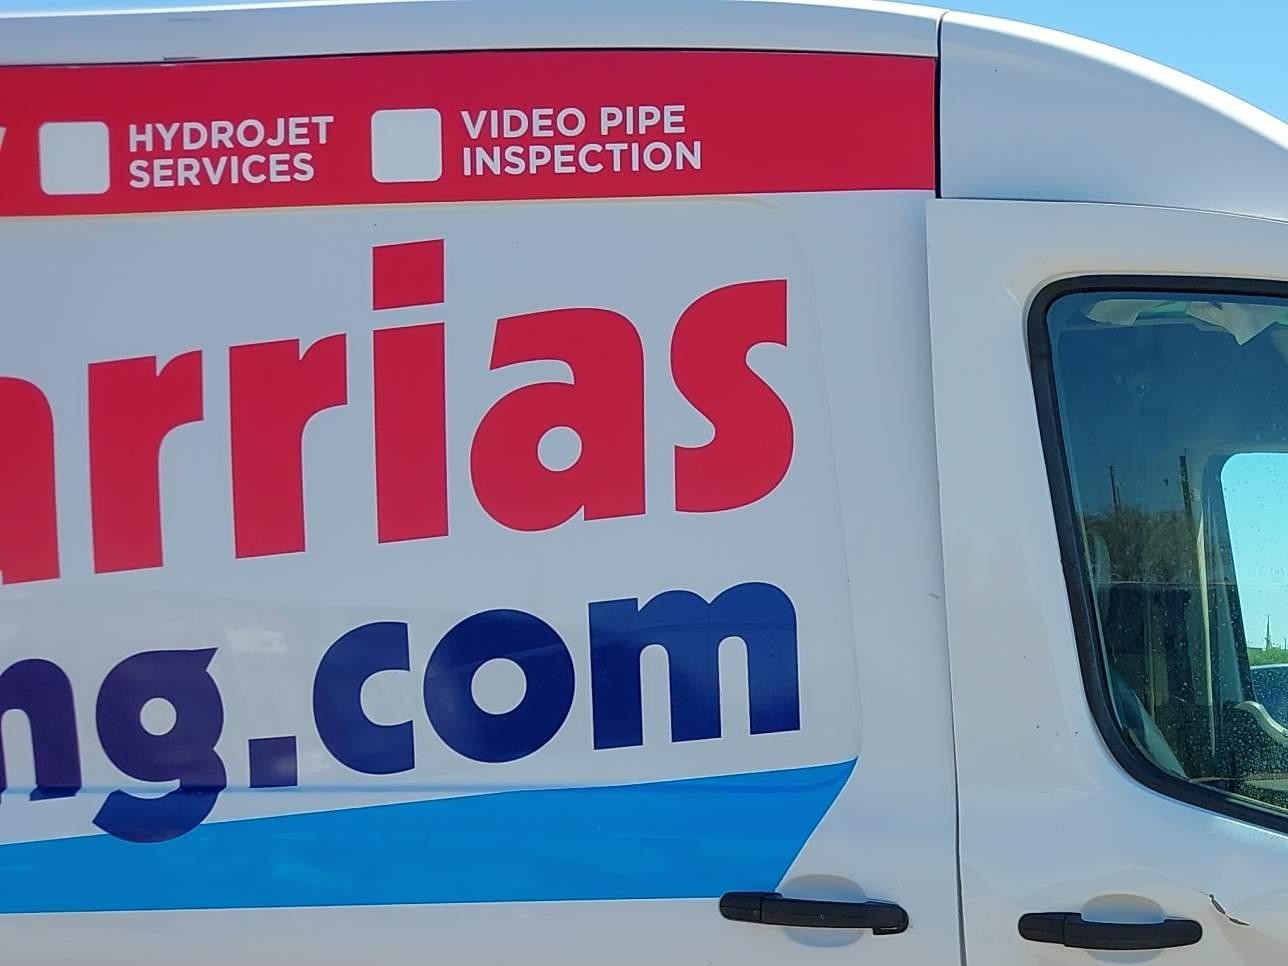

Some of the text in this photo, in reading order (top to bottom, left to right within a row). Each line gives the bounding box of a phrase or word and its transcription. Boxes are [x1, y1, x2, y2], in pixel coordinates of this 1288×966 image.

[129, 115, 334, 152] HYDROJET
[460, 104, 686, 139] VIDEO PIPE
[129, 153, 315, 189] SERVICES
[463, 140, 701, 176] INSPECTION
